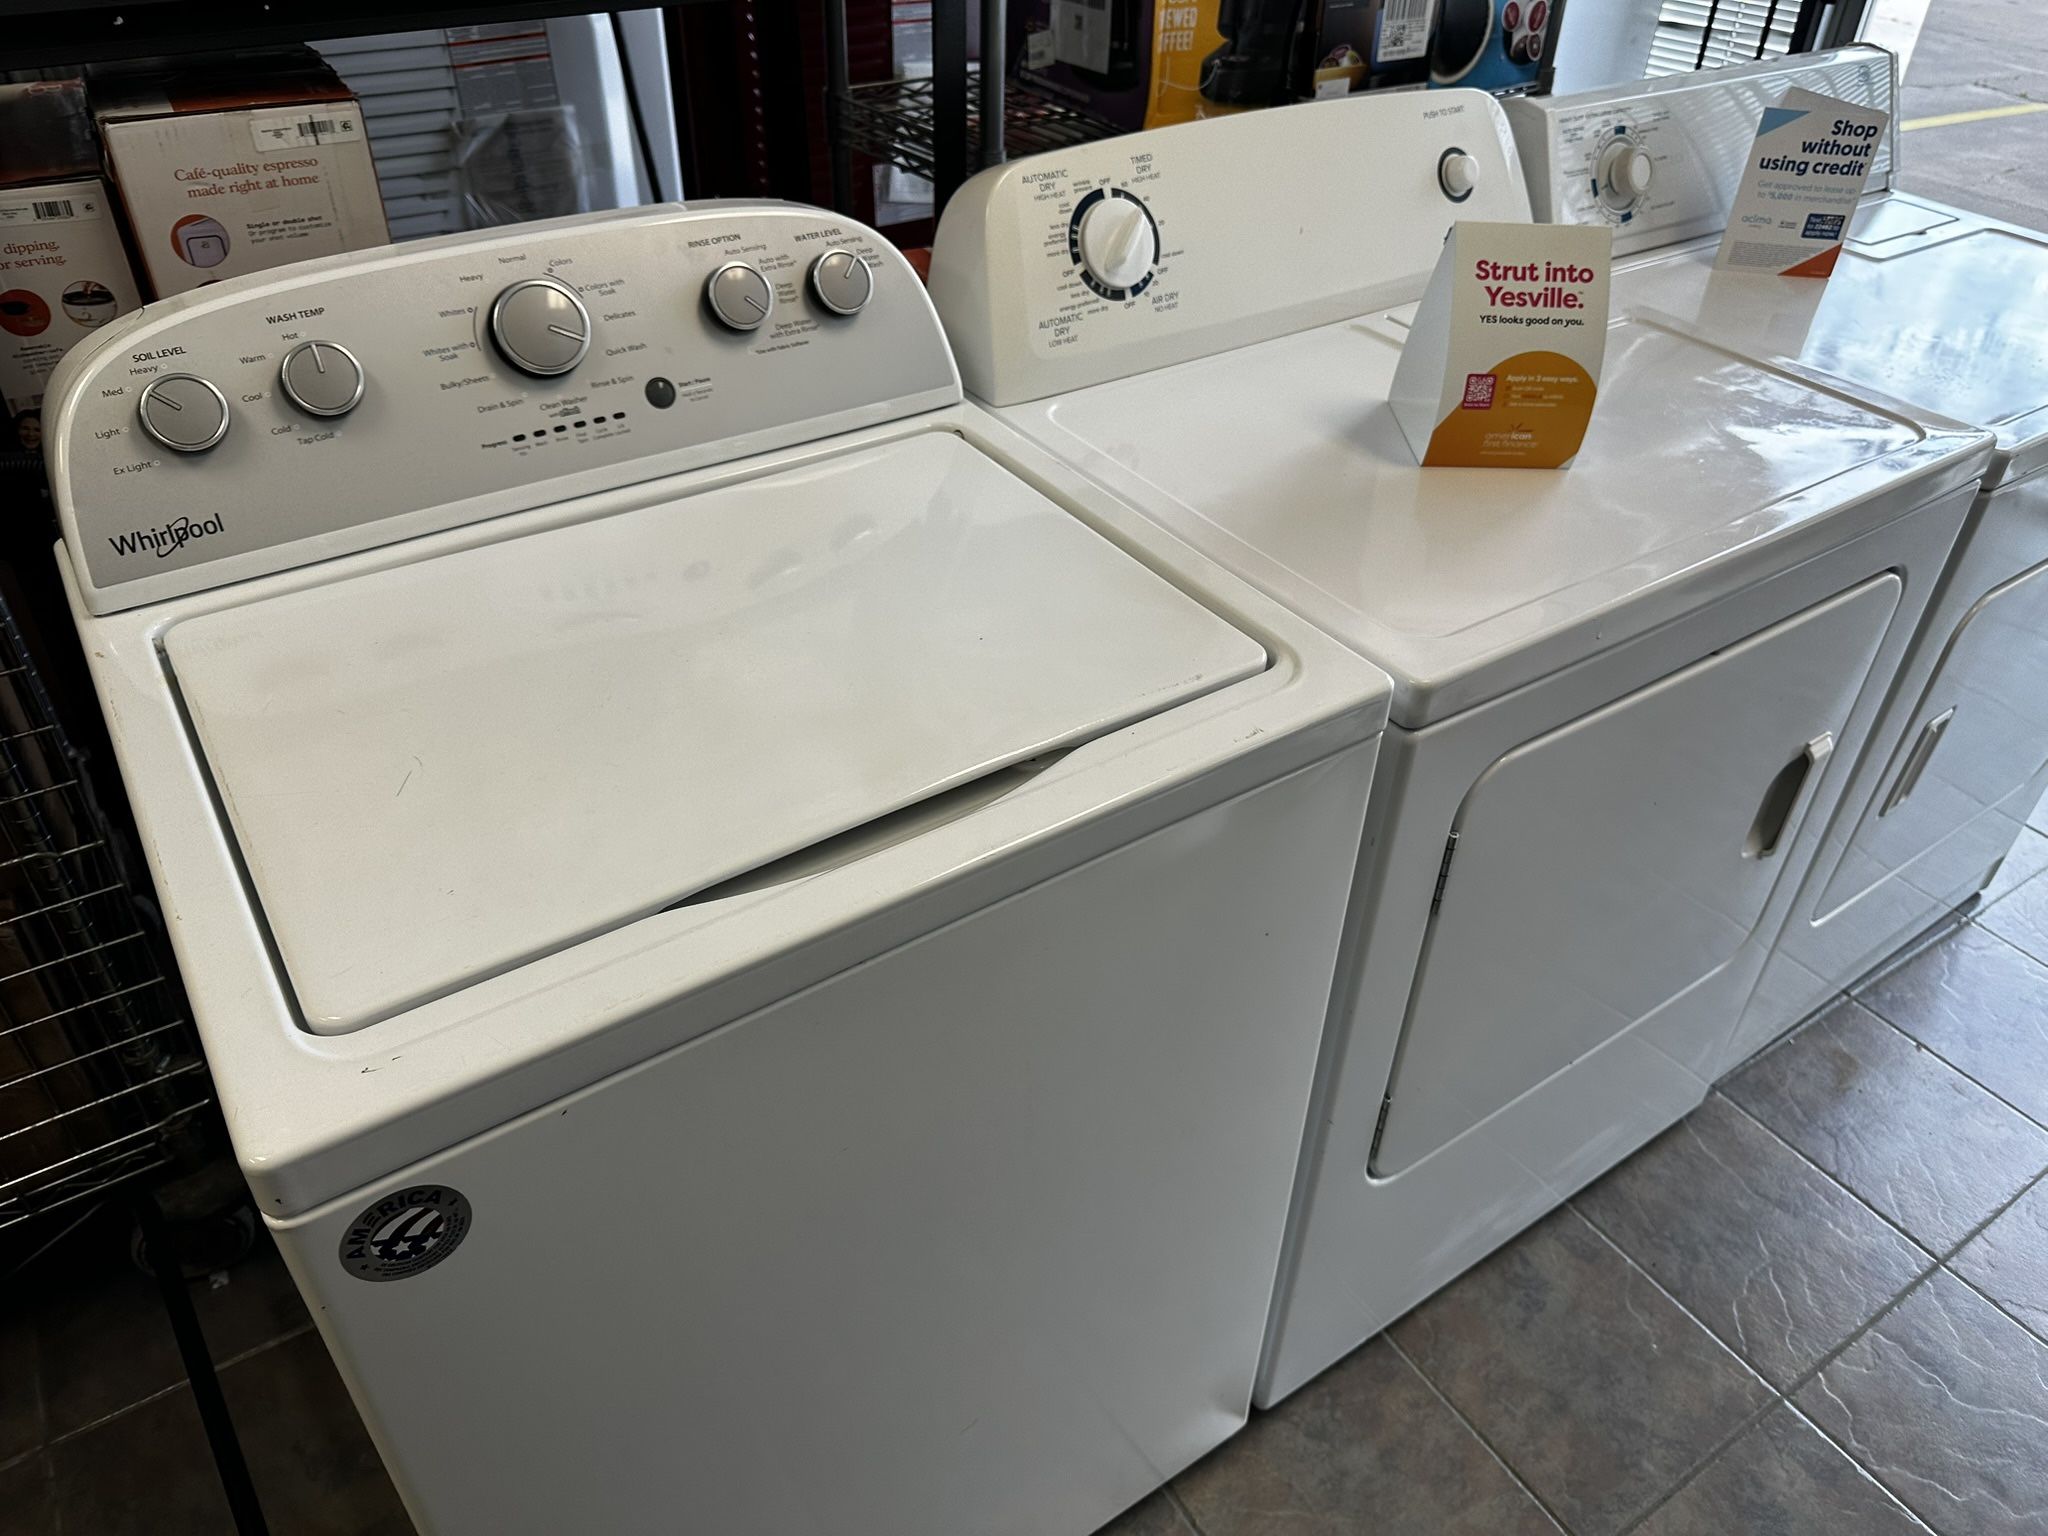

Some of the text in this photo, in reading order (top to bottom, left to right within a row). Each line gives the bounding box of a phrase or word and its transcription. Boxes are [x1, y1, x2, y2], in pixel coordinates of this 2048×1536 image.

[1423, 105, 1464, 120] PUSH TO START
[1832, 120, 1878, 141] Shop
[1802, 139, 1871, 157] without
[1130, 154, 1153, 164] TIMED
[174, 158, 319, 182] Café-quality espresso
[1136, 165, 1151, 175] DRY
[1759, 156, 1809, 176] using
[1022, 170, 1069, 185] AUTOMATIC
[1099, 178, 1111, 186] OFF
[1146, 172, 1160, 181] HEAT
[188, 175, 320, 199] made right at home
[1040, 182, 1056, 192] DRY
[1758, 181, 1772, 189] Get
[1774, 182, 1814, 192] approved
[1845, 187, 1857, 195] up
[1034, 190, 1066, 201] HIGH HEAT
[794, 228, 843, 242] WATER LEVEL
[840, 236, 864, 245] Sensing
[688, 234, 741, 249] RINSE OPTION
[4, 241, 60, 256] dipping.
[741, 245, 767, 253] Sensing
[15, 255, 67, 269] serving.
[498, 254, 527, 264] Normal
[549, 259, 573, 267] Colors
[761, 265, 777, 273] Extra
[1063, 270, 1075, 278] OFF
[1157, 267, 1169, 275] OFF
[1476, 260, 1594, 284] Strut into
[460, 274, 483, 282] Heavy
[585, 279, 625, 291] Colors with
[598, 288, 616, 297] Soak
[1152, 292, 1179, 306] AIR DRY
[1124, 301, 1136, 310] OFF
[1165, 302, 1179, 311] HEAT
[266, 307, 325, 325] WASH TEMP
[439, 309, 466, 318] Whites
[604, 311, 637, 322] Delicates
[775, 323, 793, 331] Deep
[1039, 313, 1084, 329] AUTOMATIC
[1480, 315, 1498, 324] YES
[1499, 316, 1524, 325] looks
[1525, 317, 1551, 327] good
[1564, 319, 1585, 328] you.
[282, 332, 299, 341] Hot
[785, 329, 801, 337] Extra
[1054, 327, 1070, 337] DRY
[1049, 335, 1079, 348] LOW HEAT
[133, 346, 187, 363] SOIL LEVEL
[423, 343, 469, 357] Whites with
[606, 342, 648, 356] Quick Wash
[240, 354, 266, 365] Warm
[439, 353, 459, 362] Soak
[129, 364, 159, 377] Heavy
[618, 376, 635, 384] Spin
[1506, 375, 1528, 384] Apply
[102, 387, 124, 399] Med
[242, 393, 263, 403] Cool
[477, 404, 499, 414] Drain
[506, 399, 524, 409] Spin
[540, 402, 561, 412] Clean
[561, 396, 588, 406] Washer
[95, 428, 121, 440] Light
[271, 426, 292, 436] Cold
[297, 432, 335, 446] Tap Cold
[114, 461, 153, 476] Ex Light
[109, 513, 225, 558] Whirlpool
[347, 1190, 443, 1260] AMERICA
